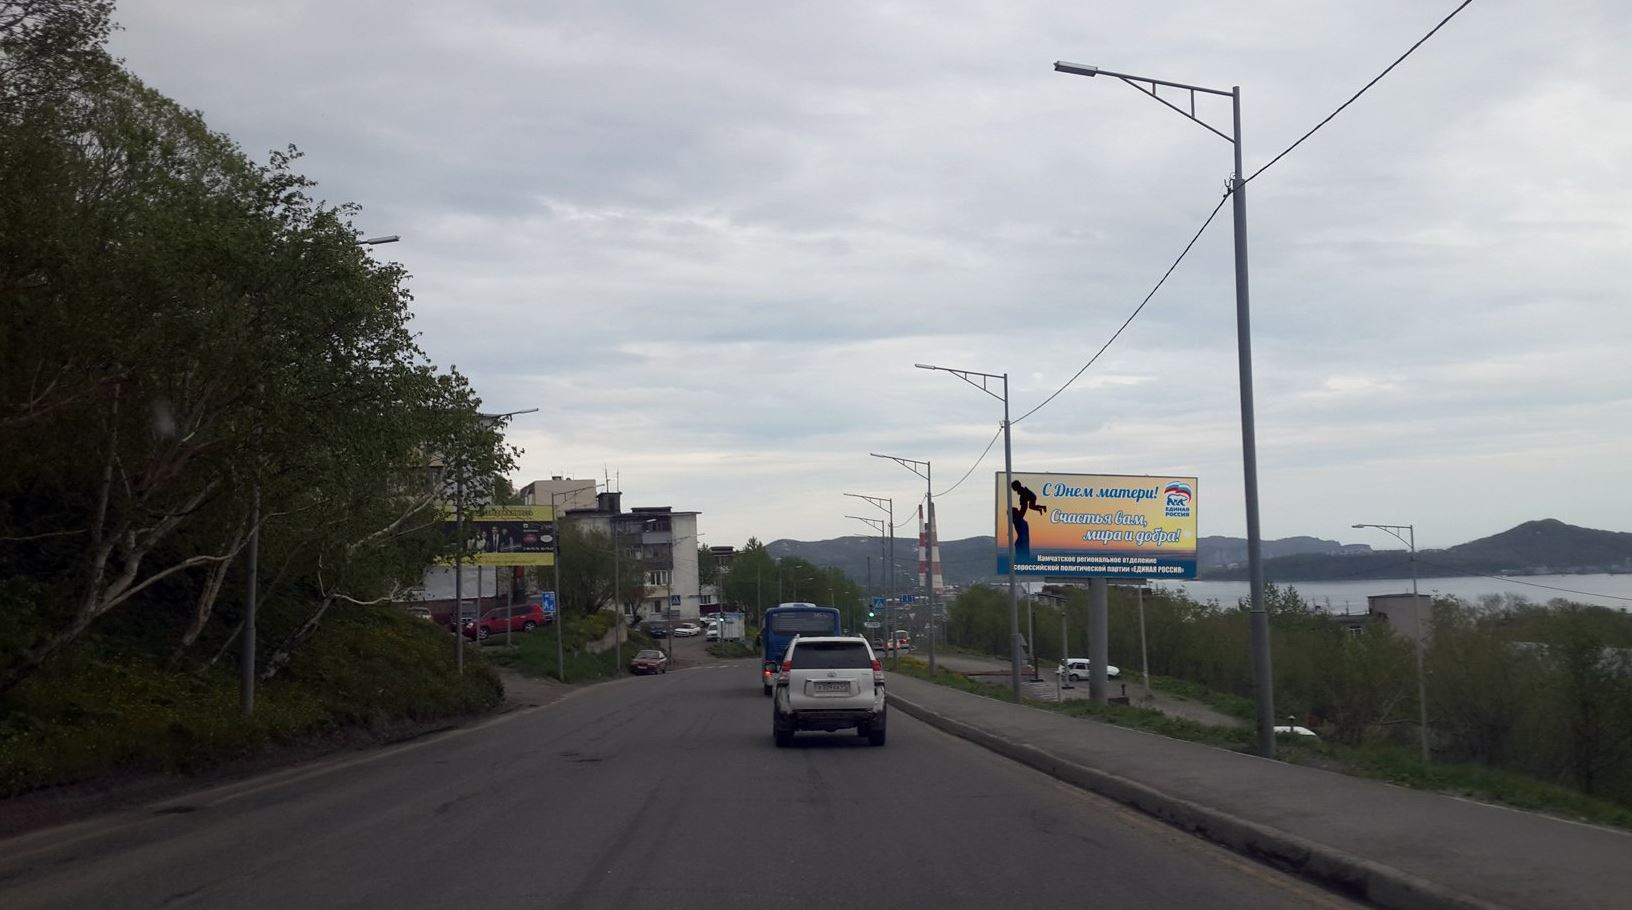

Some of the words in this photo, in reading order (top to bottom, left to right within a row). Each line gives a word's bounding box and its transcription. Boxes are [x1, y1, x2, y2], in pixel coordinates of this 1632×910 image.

[1042, 482, 1052, 497] С
[1054, 483, 1093, 498] Днем
[1096, 485, 1159, 503] матери!
[1050, 508, 1113, 525] Счастья
[1114, 510, 1148, 527] вам,
[1082, 529, 1122, 545] мира
[1124, 530, 1133, 541] и
[1135, 527, 1181, 546] добра!
[1037, 554, 1076, 562] Камчатское
[1076, 556, 1121, 564] региональное
[1060, 564, 1106, 572] политической
